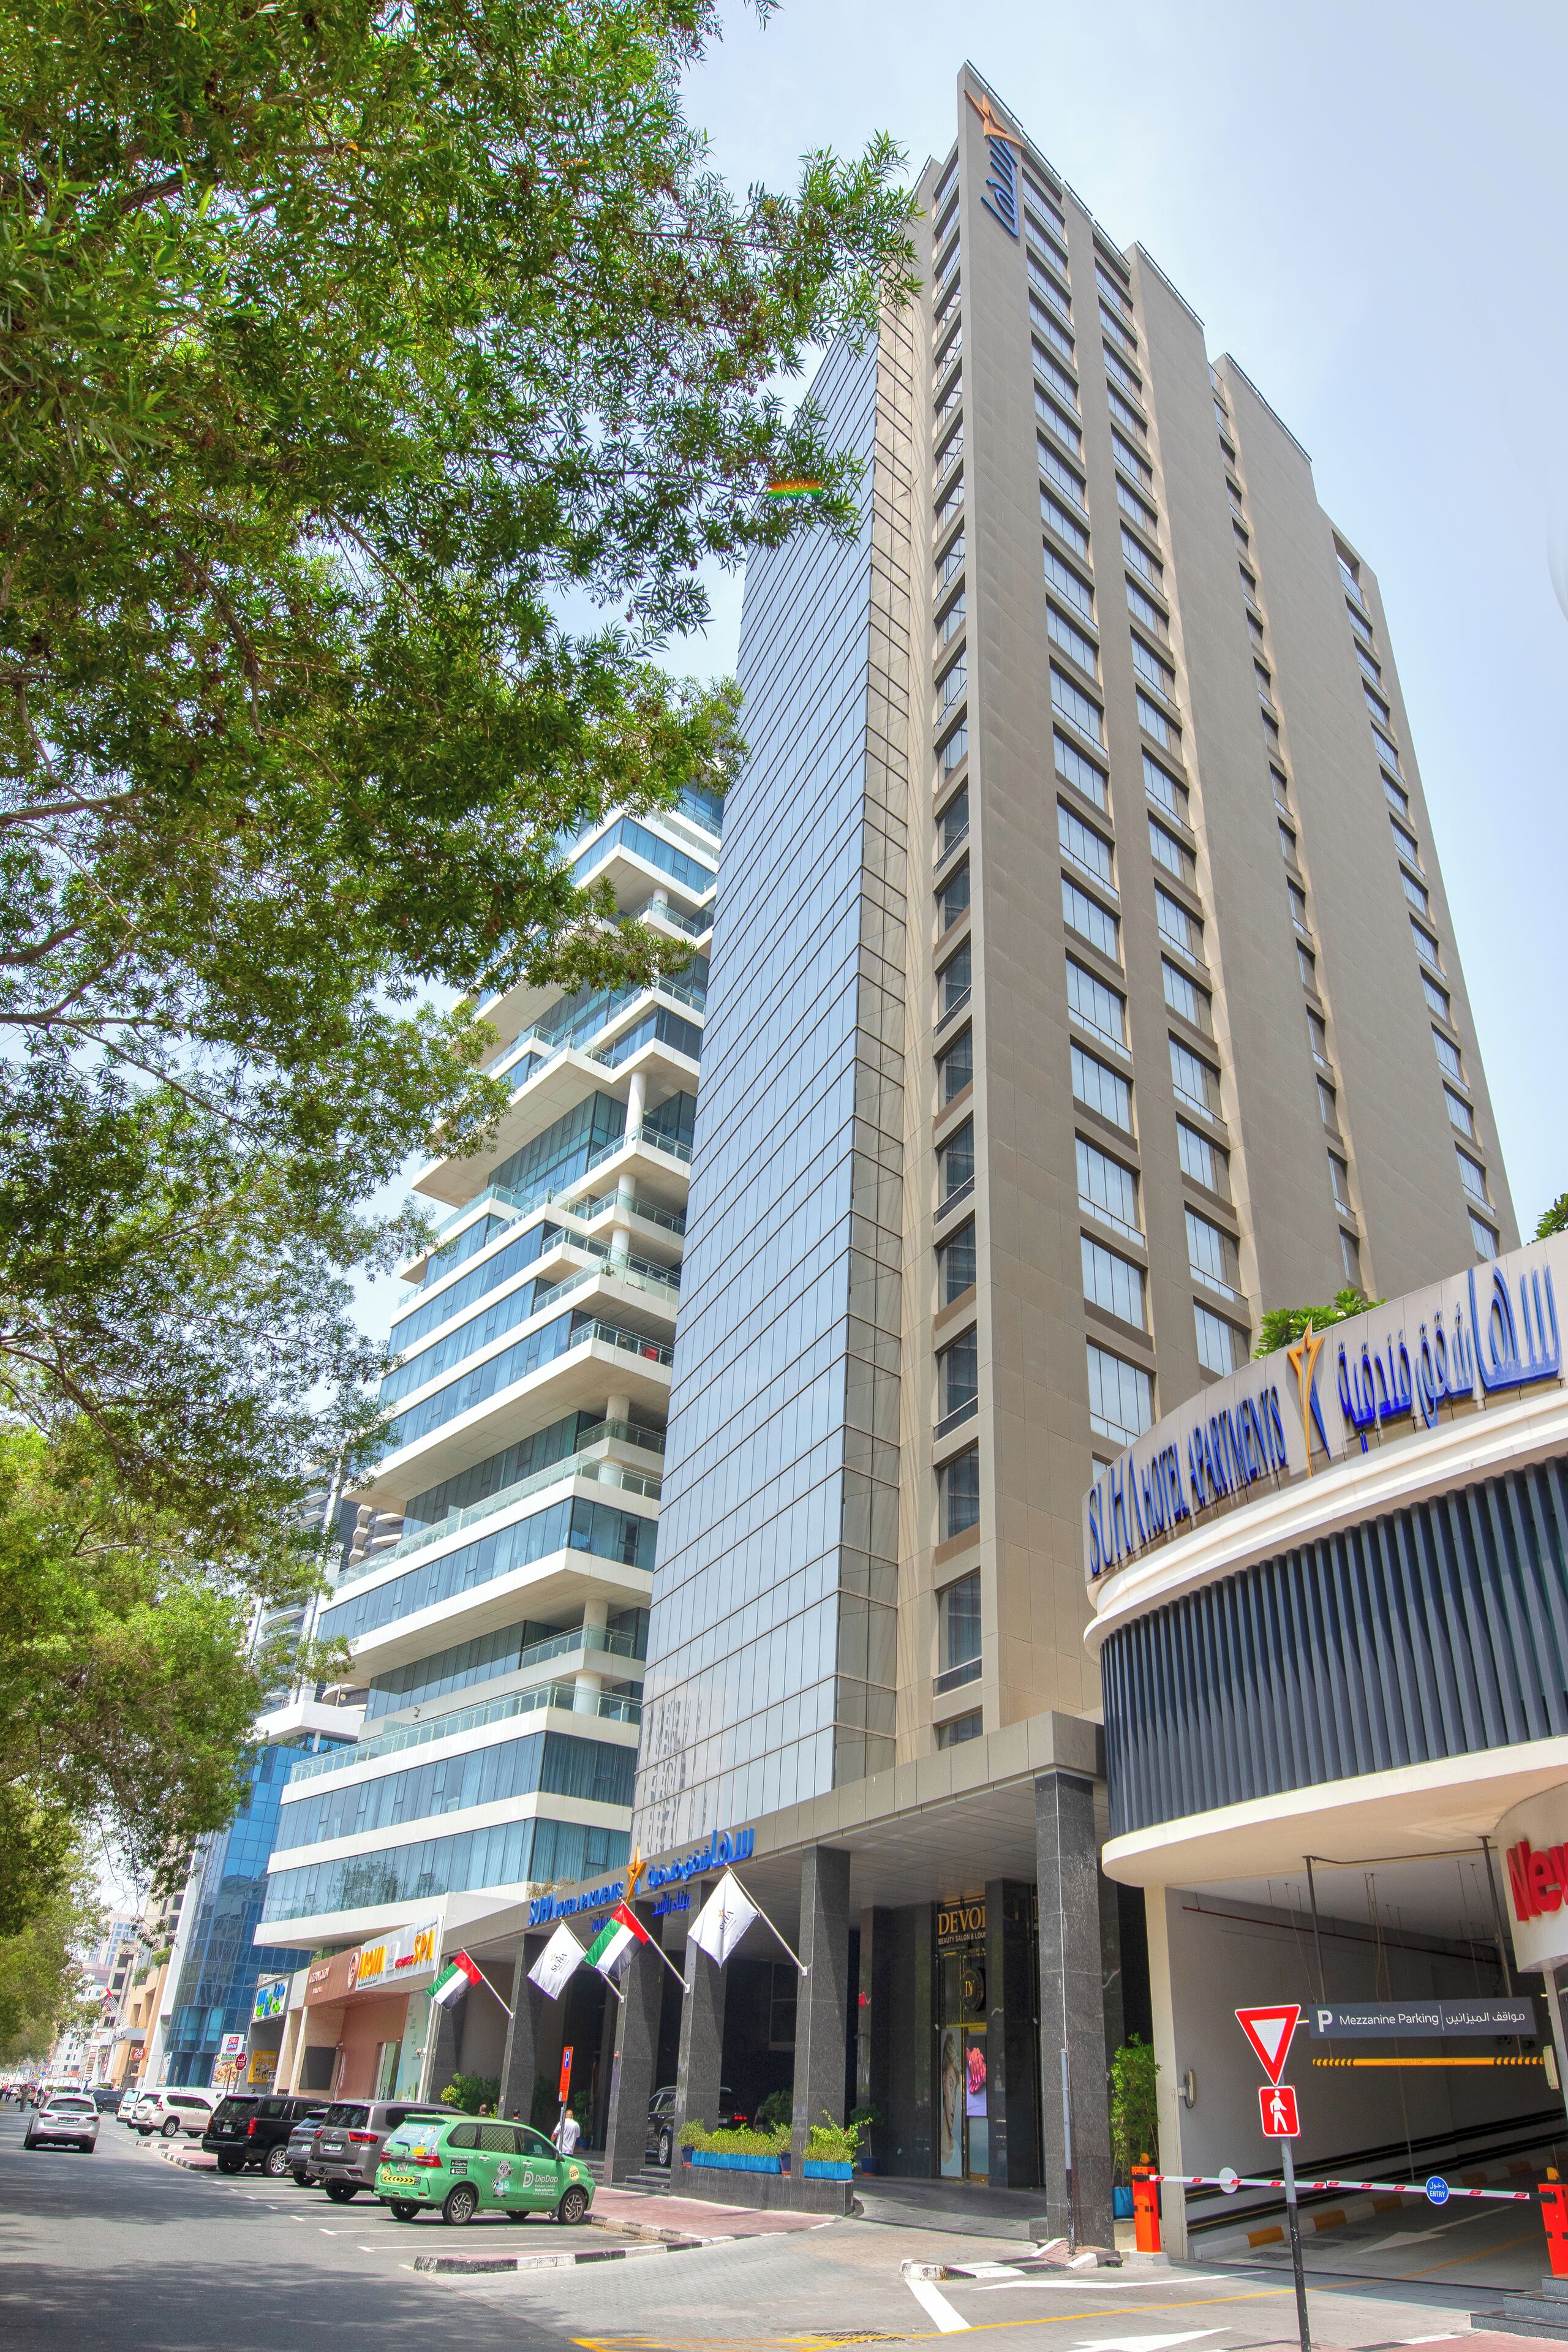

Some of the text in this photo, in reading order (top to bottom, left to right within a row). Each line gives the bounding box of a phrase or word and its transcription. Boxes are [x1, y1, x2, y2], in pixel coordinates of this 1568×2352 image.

[1468, 1264, 1560, 1393] سها
[1089, 1385, 1286, 1576] SUHA HOTEL APARTMENTS
[527, 1882, 624, 1926] SUHA HOTEL APARTMENTS
[720, 1910, 734, 1931] SHA
[413, 1930, 435, 1964] SPA
[938, 1936, 954, 1945] BEAUTY
[551, 1953, 567, 1973] SUHA
[1317, 2010, 1439, 2032] P Mezzanine Parking
[1446, 2011, 1525, 2024] مواقف الميزانين
[535, 2175, 558, 2184] DipDap
